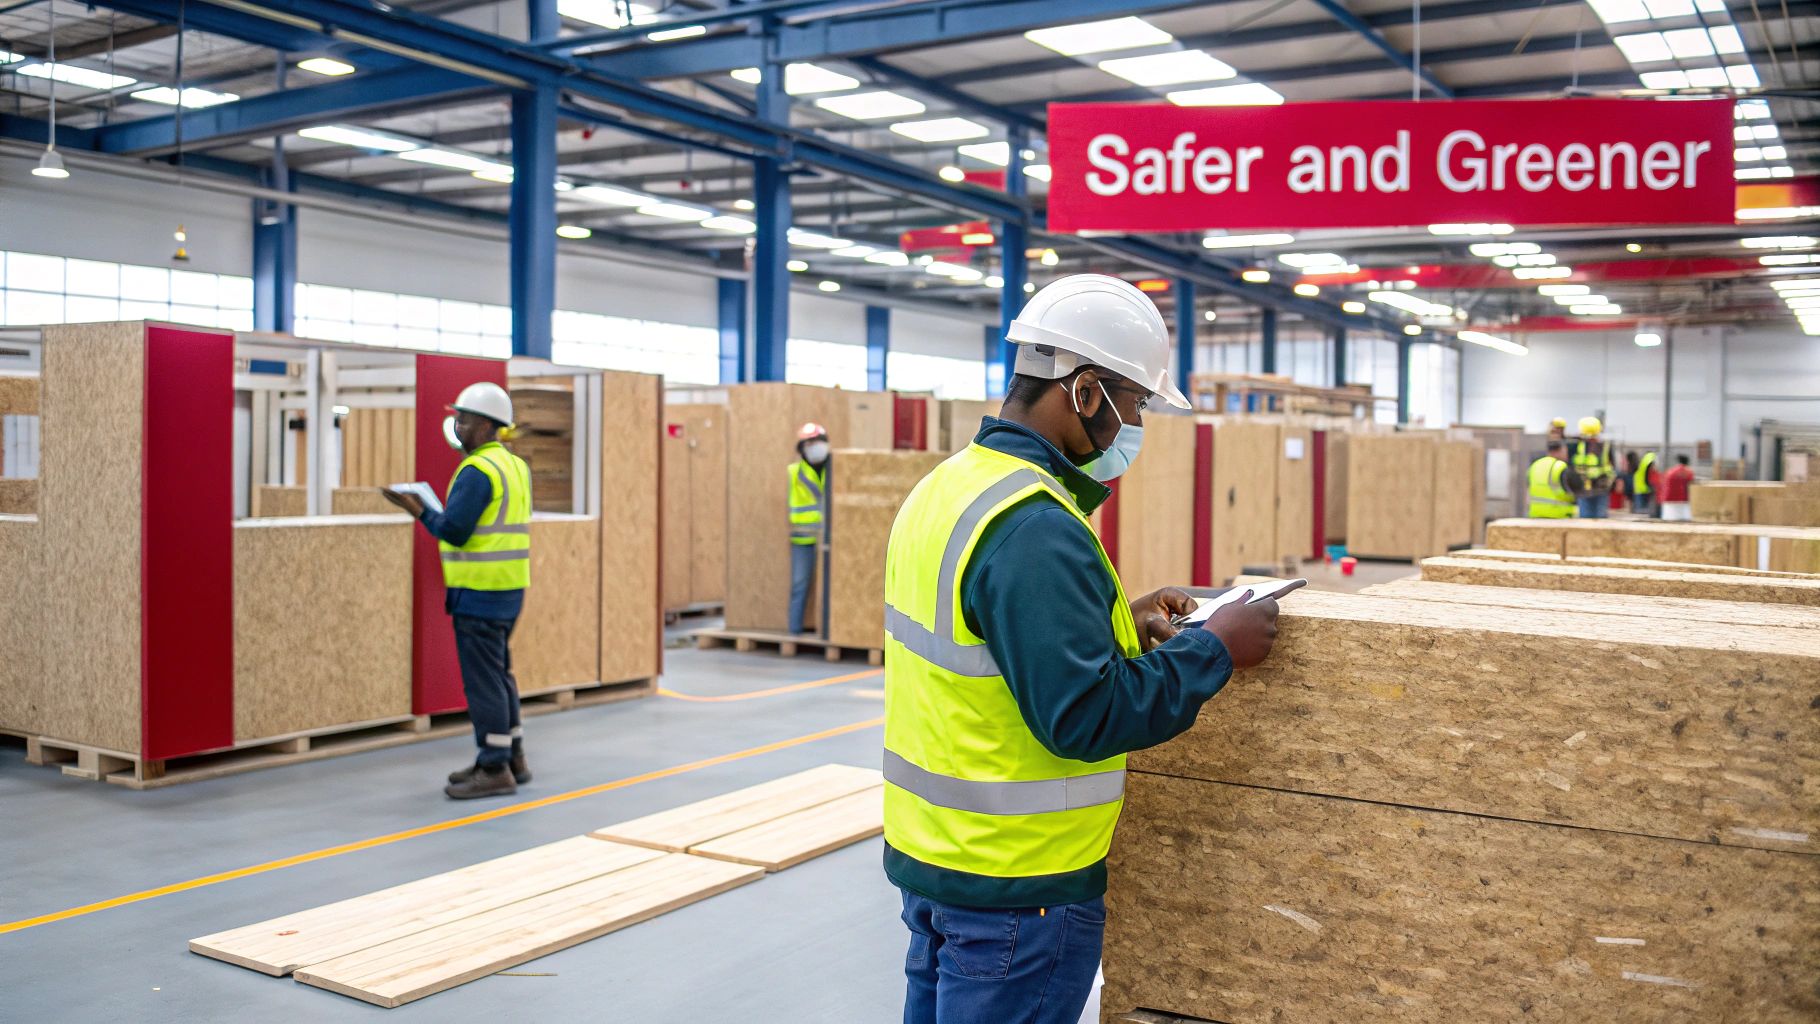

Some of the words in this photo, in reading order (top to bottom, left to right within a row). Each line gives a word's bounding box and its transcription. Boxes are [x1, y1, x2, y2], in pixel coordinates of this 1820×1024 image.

[1085, 132, 1263, 196] Safer
[1287, 130, 1410, 194] and
[1436, 129, 1711, 192] Greener
